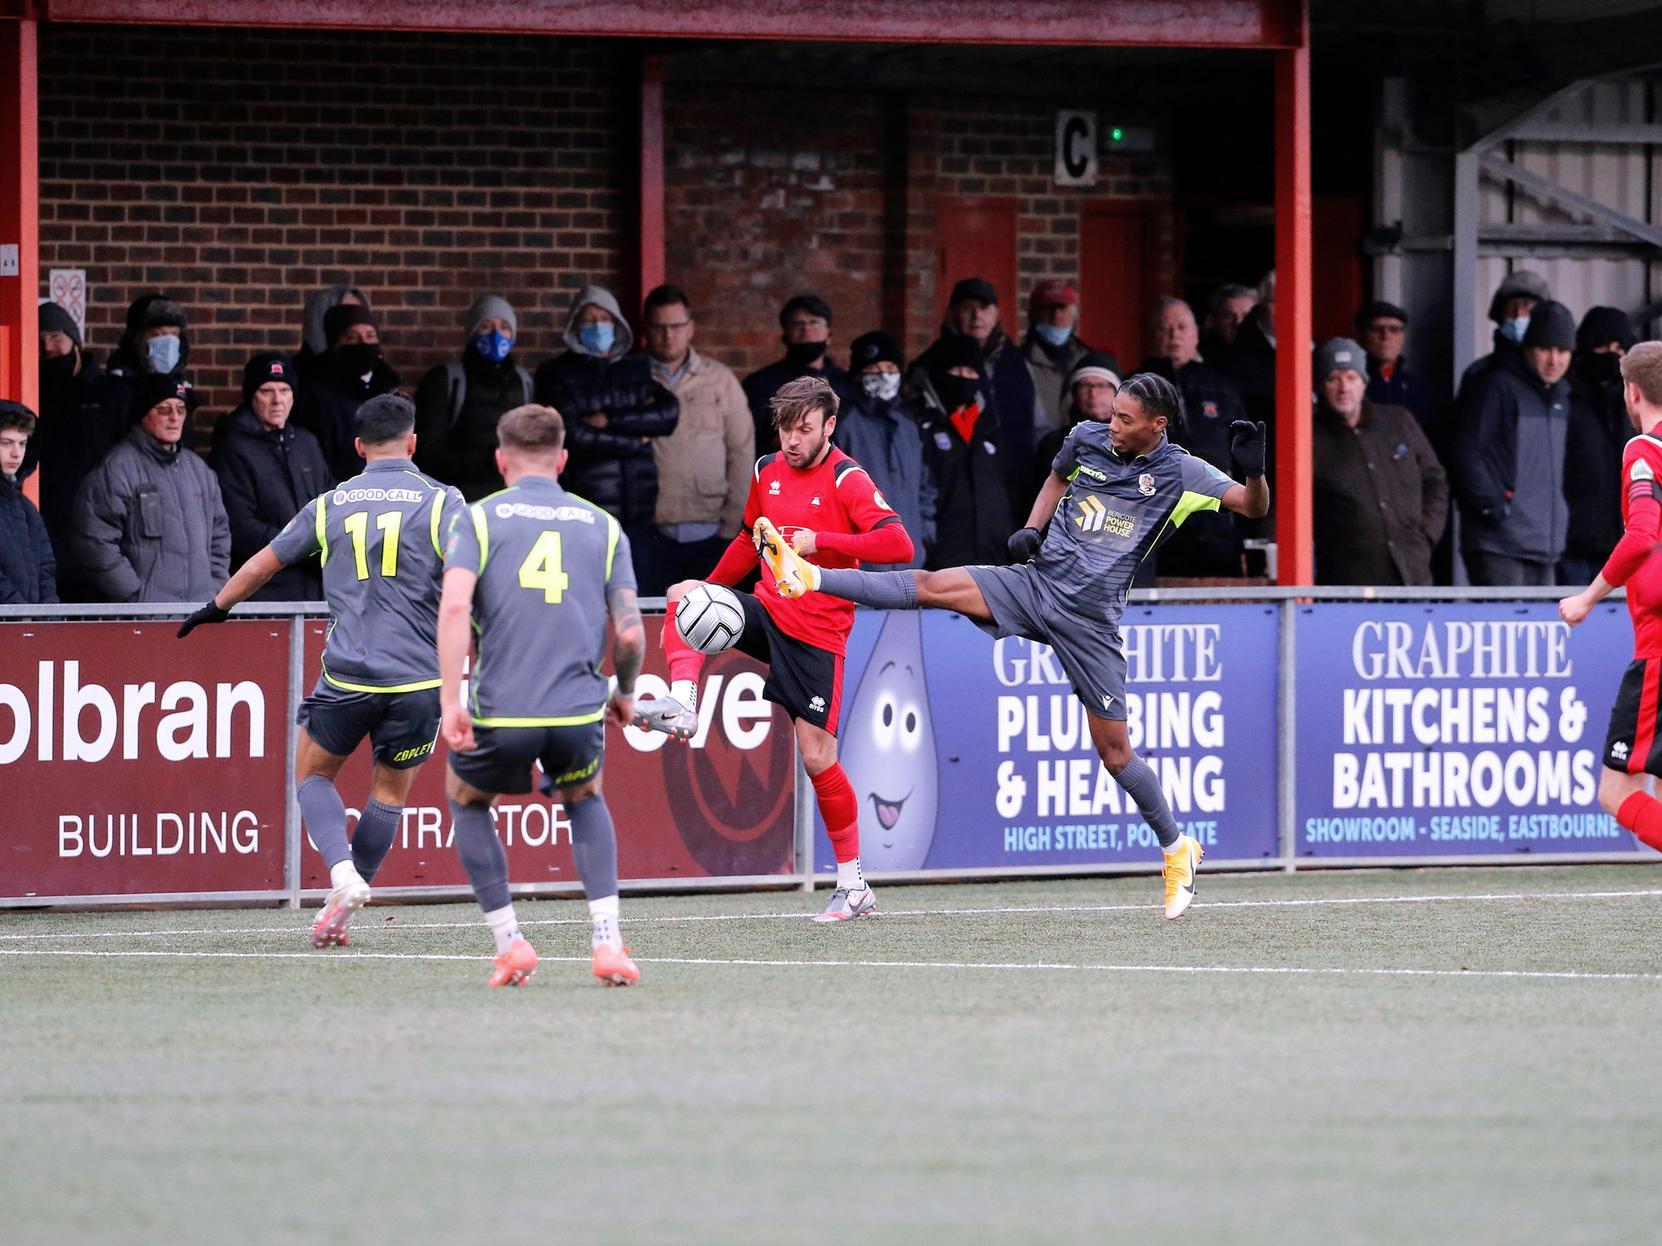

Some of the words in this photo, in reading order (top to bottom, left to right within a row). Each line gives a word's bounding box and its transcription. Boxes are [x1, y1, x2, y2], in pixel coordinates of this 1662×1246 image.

[1063, 116, 1089, 179] C
[348, 489, 385, 502] GOOD
[1106, 515, 1134, 531] POWER
[344, 511, 403, 581] 11
[1103, 523, 1131, 538] HOUSE
[518, 530, 569, 604] 4
[992, 623, 1224, 687] GRHITE
[1352, 619, 1573, 680] GRAPHITE
[1343, 687, 1550, 745] KITCHENS
[1558, 686, 1588, 743] &
[995, 760, 1026, 819] &
[1036, 755, 1225, 817] HEANG
[1332, 749, 1597, 809] BATHROOMS
[58, 810, 260, 857] BUILDING
[1004, 826, 1051, 852] HIGH
[1305, 816, 1416, 843] SHOWROOM
